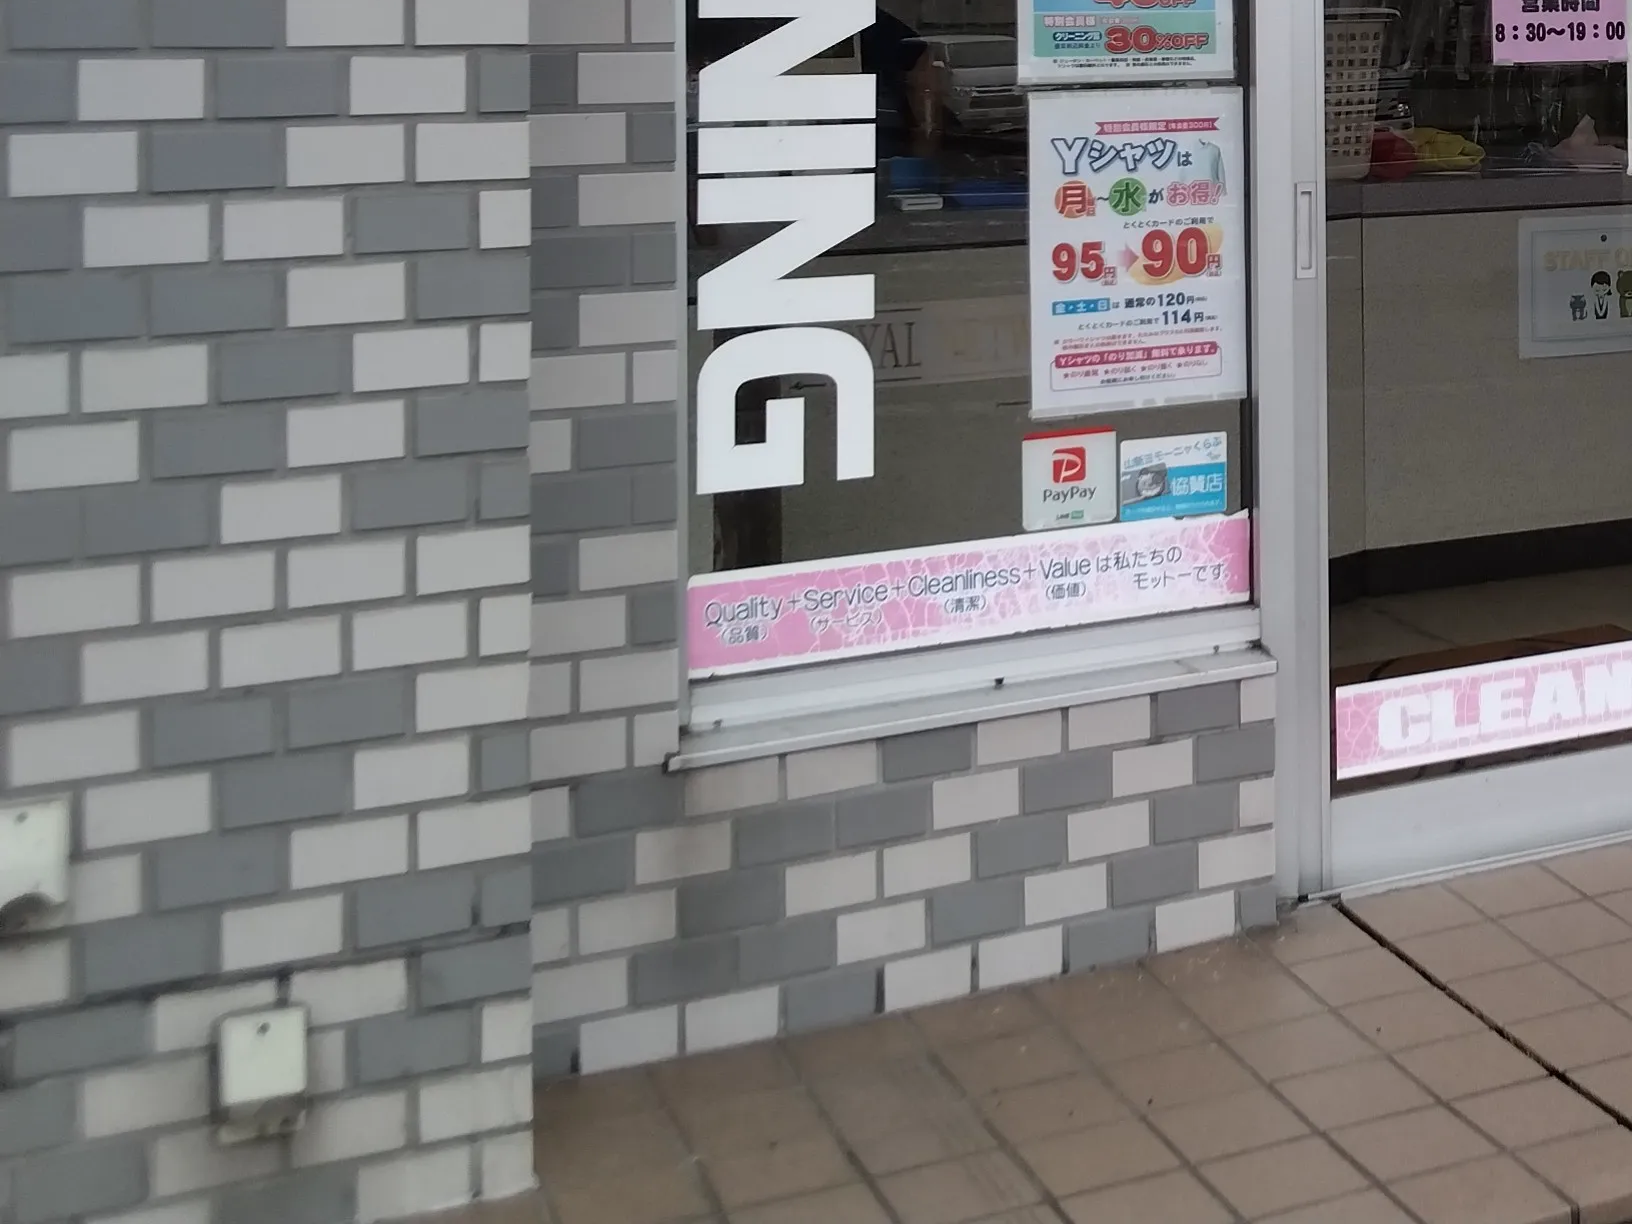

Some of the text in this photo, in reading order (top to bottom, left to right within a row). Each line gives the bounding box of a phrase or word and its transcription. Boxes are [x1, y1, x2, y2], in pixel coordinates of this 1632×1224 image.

[1543, 249, 1611, 272] STAFF
[1043, 486, 1098, 502] PayPay
[1133, 562, 1225, 590] モットーです
[706, 595, 782, 627] Quality
[804, 583, 889, 612] Service
[908, 568, 1021, 598] Cleanliness
